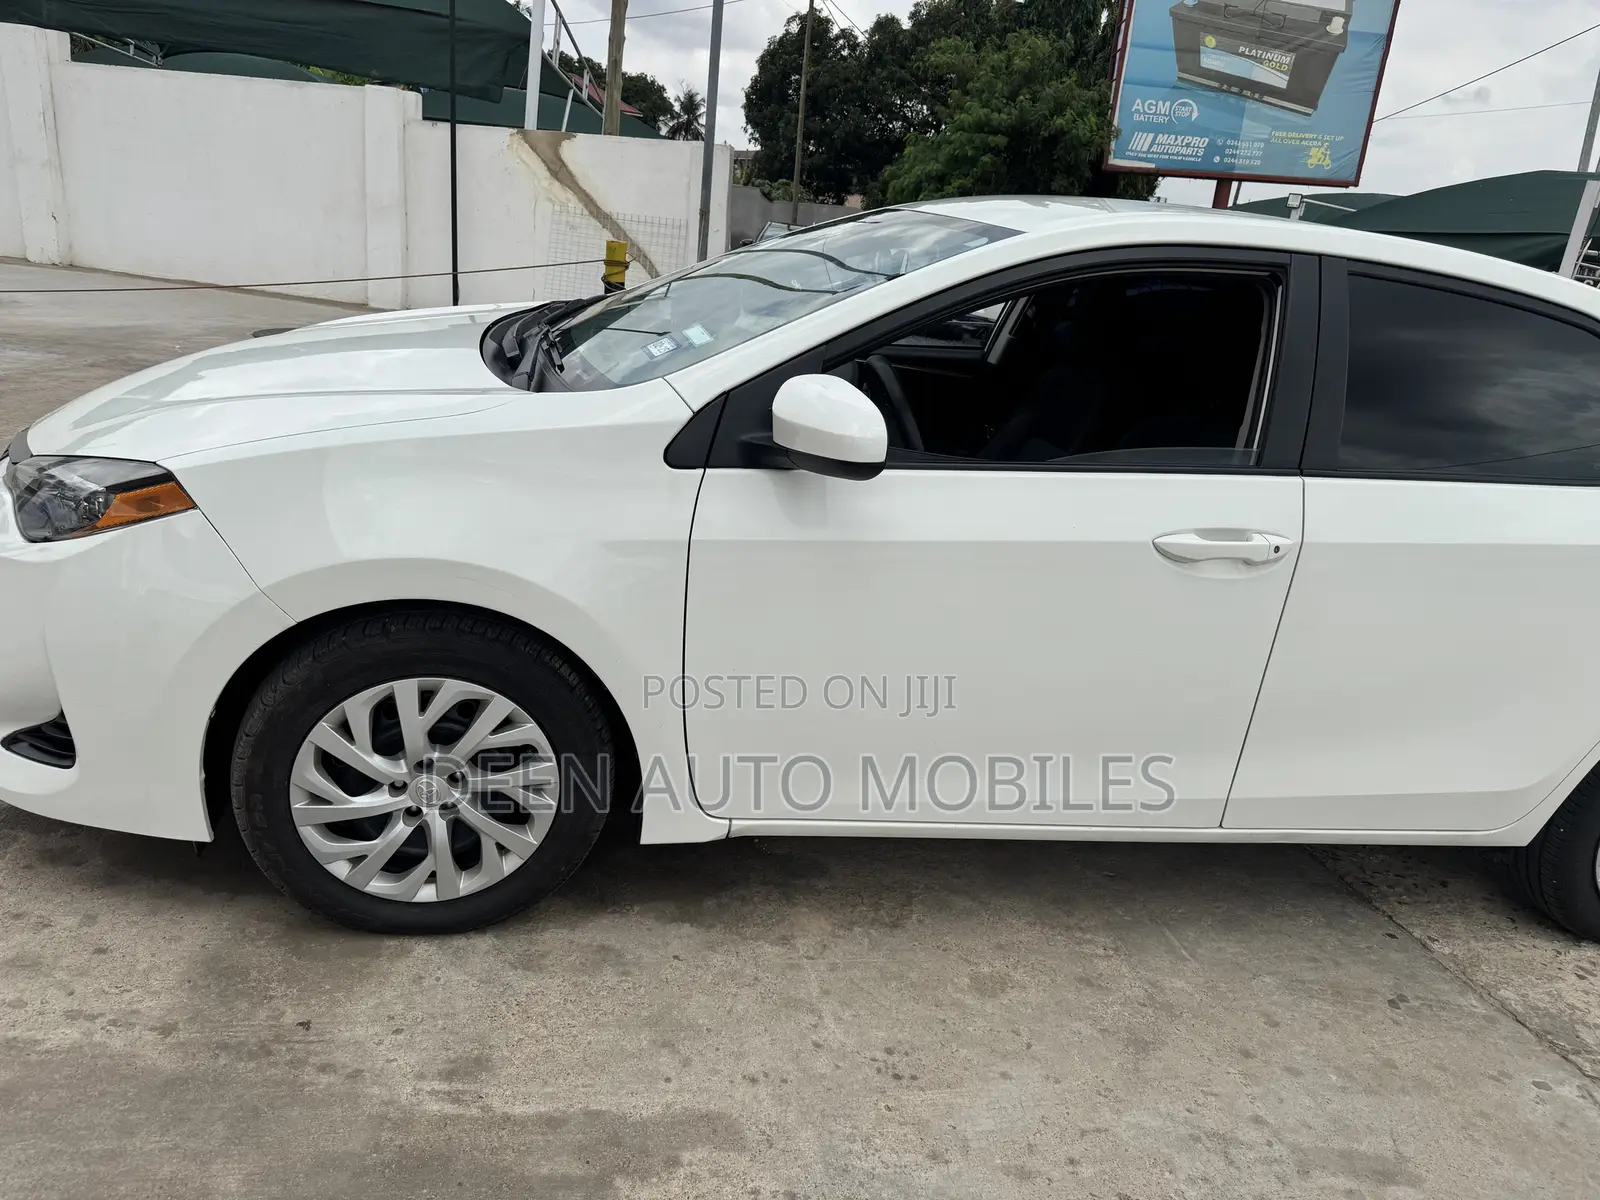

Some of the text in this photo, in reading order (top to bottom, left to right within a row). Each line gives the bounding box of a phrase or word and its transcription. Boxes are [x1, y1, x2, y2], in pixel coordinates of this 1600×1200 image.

[1238, 46, 1291, 64] PLATINUM
[1263, 60, 1288, 71] GOLD
[1132, 98, 1170, 115] AGM
[1134, 114, 1170, 123] BATTERY
[1155, 134, 1209, 148] MAXPRO
[1150, 144, 1204, 156] AUTOPARTS
